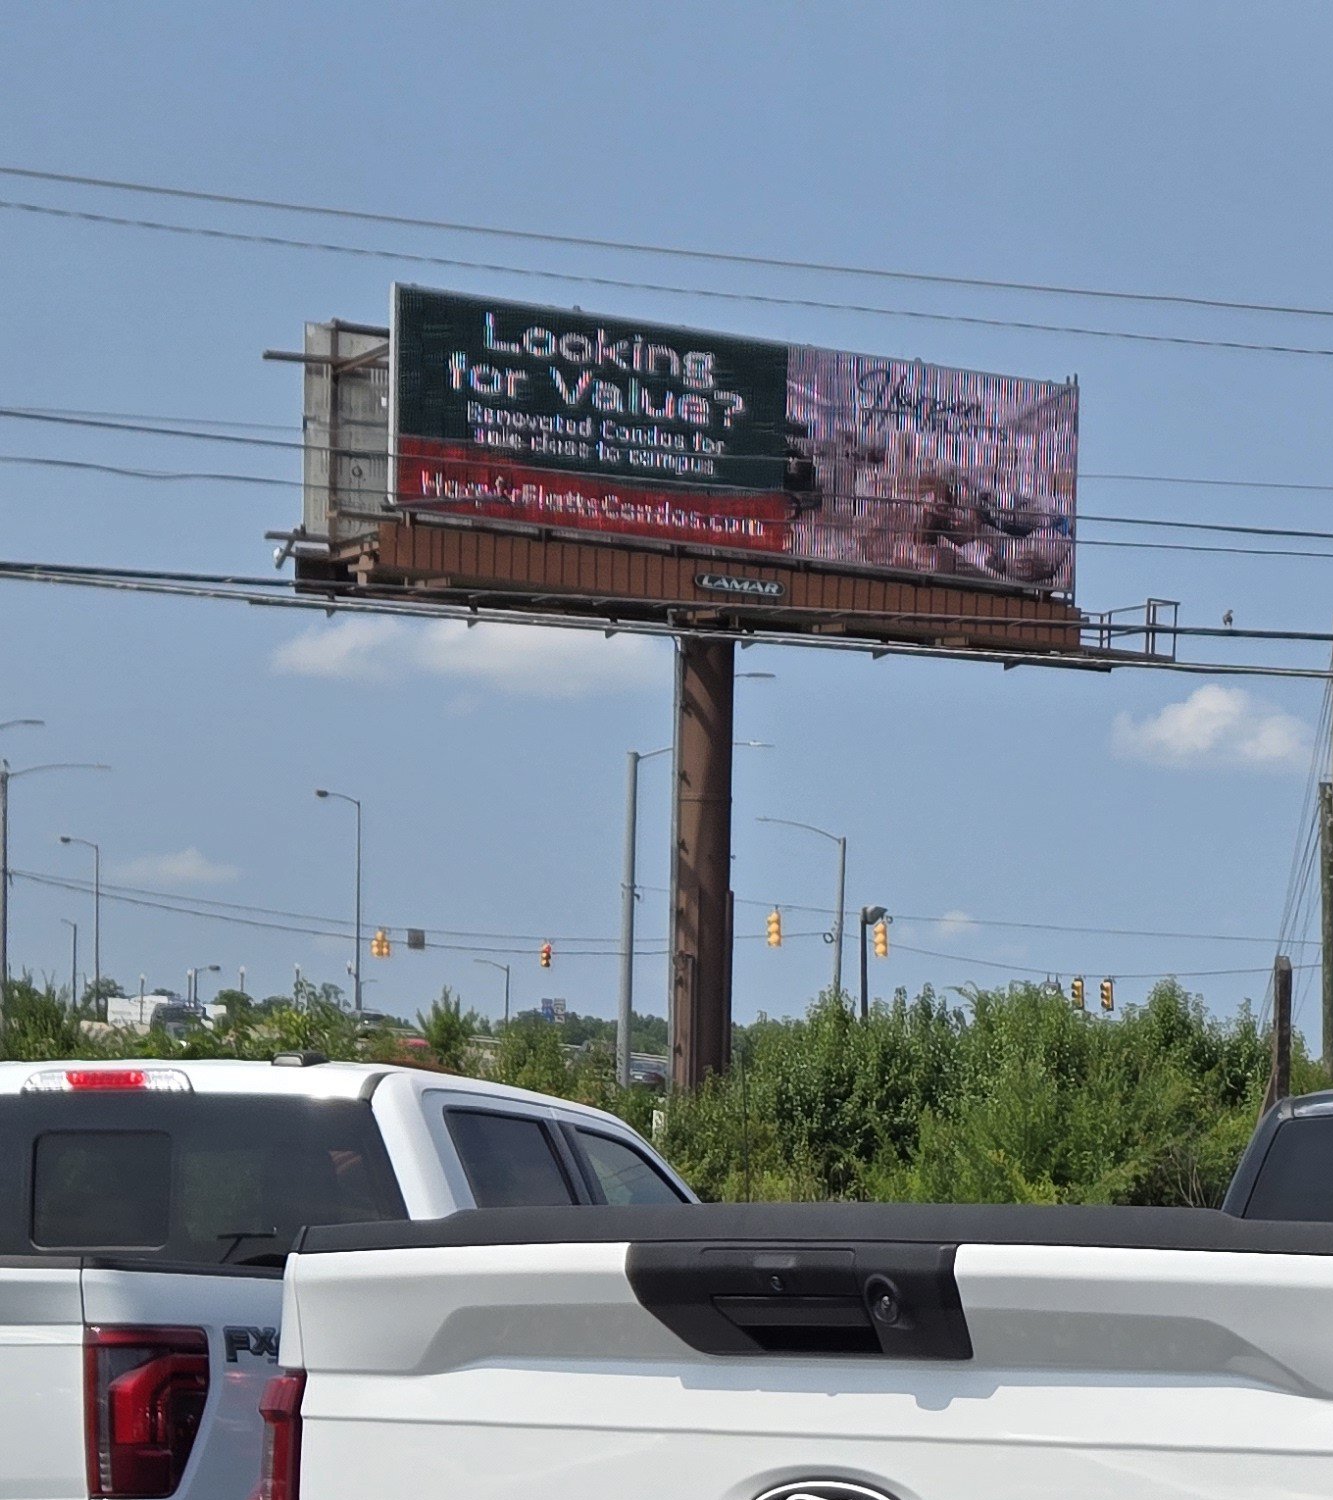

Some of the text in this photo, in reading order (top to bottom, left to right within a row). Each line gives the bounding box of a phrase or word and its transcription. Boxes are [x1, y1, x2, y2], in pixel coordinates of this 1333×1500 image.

[484, 312, 715, 389] Looking
[449, 351, 745, 428] for Value?
[600, 419, 685, 449] Condos
[702, 575, 780, 594] LAMAR
[223, 1326, 280, 1363] FX
